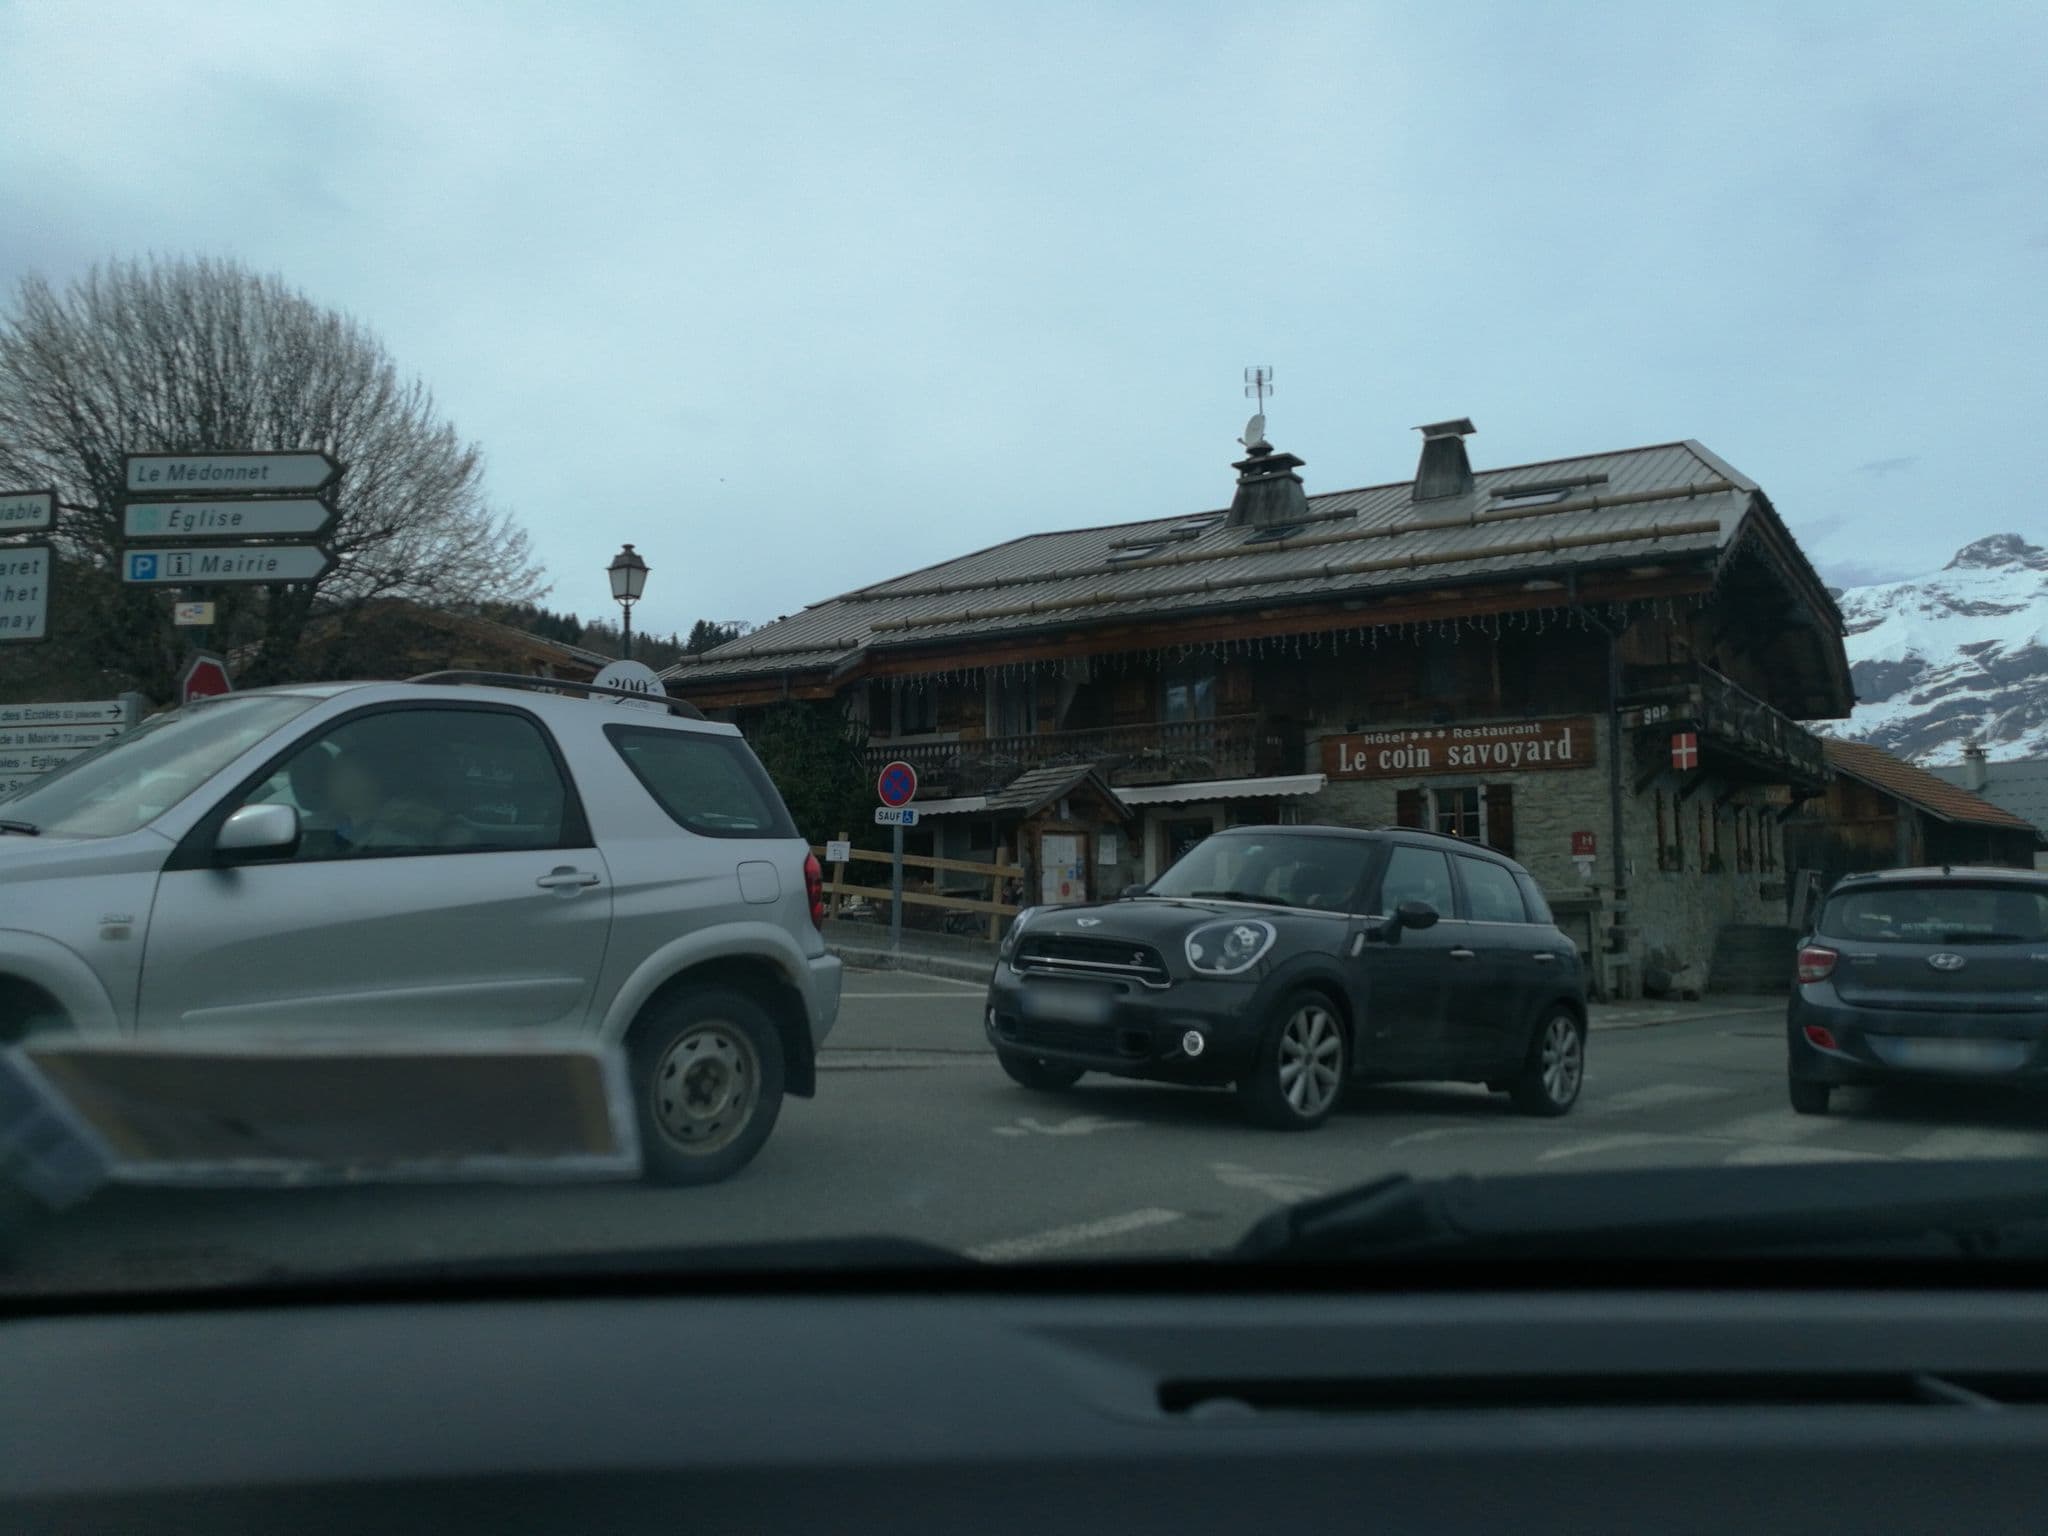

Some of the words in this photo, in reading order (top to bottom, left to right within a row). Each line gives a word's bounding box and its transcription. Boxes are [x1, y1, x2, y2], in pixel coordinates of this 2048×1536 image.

[136, 465, 161, 483] Le
[166, 463, 270, 482] Médonnet
[167, 505, 243, 533] Église
[201, 554, 278, 574] Mairie
[0, 585, 39, 602] het
[1364, 731, 1406, 746] Hôtel
[1452, 722, 1542, 739] Restaurant
[1338, 743, 1368, 773] Le
[1378, 743, 1431, 770] coin
[1447, 727, 1573, 768] savoyard
[878, 810, 902, 821] SAUF
